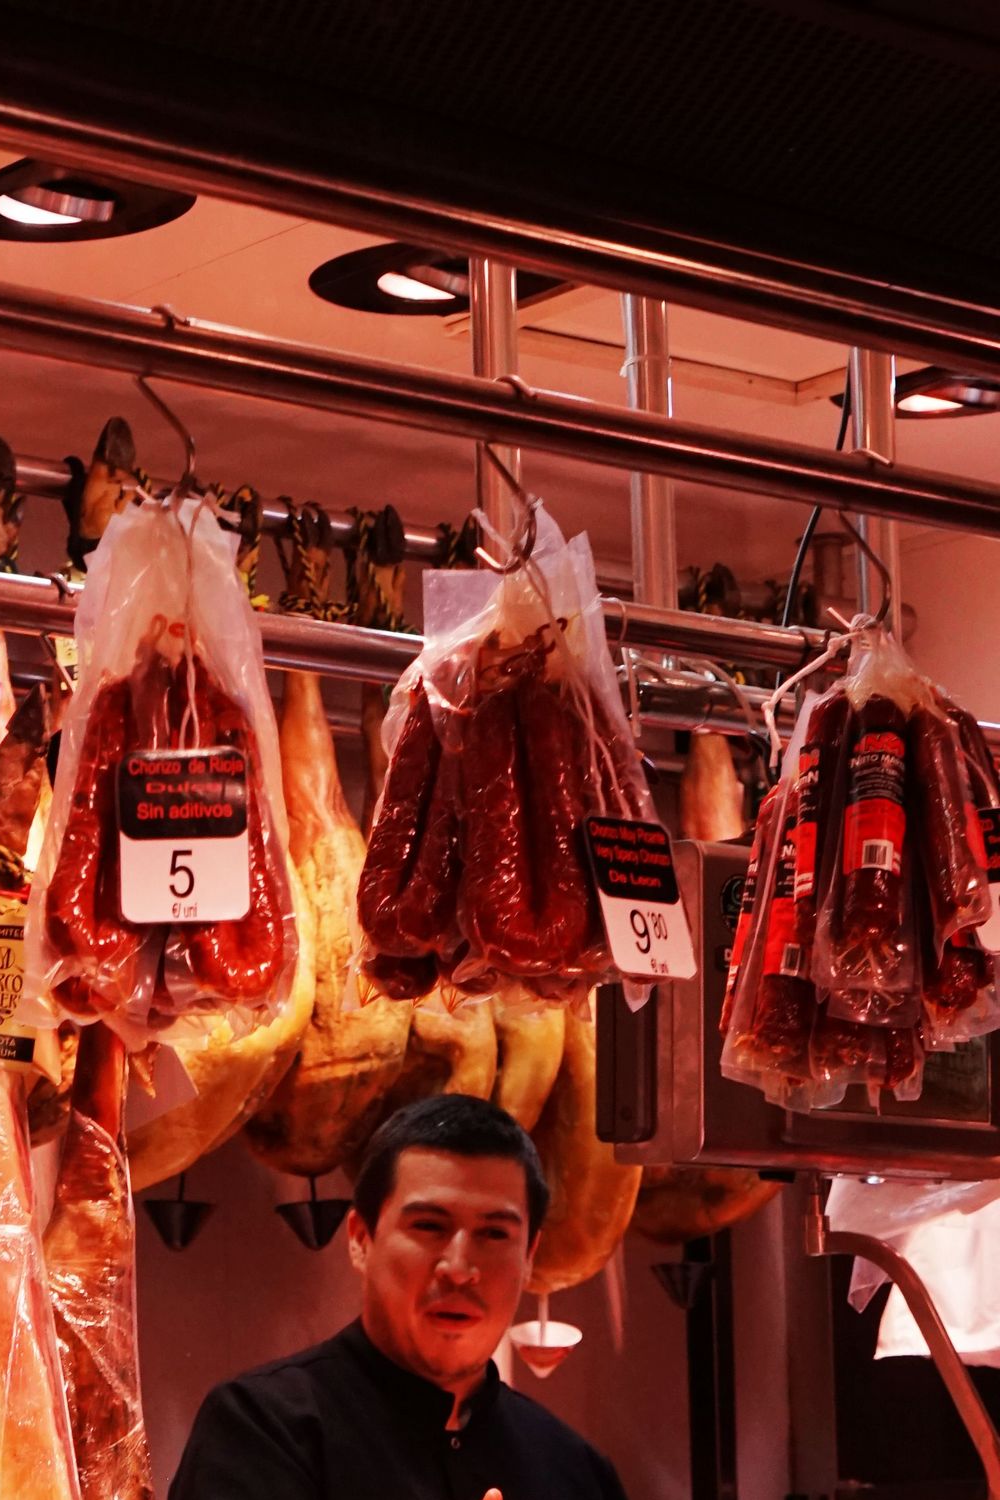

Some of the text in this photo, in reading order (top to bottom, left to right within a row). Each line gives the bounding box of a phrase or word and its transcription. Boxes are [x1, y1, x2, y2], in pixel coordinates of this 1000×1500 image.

[128, 757, 244, 777] Chorizo de Rioja
[137, 802, 233, 820] Sin aditivos
[169, 850, 195, 899] 5
[609, 869, 628, 884] De
